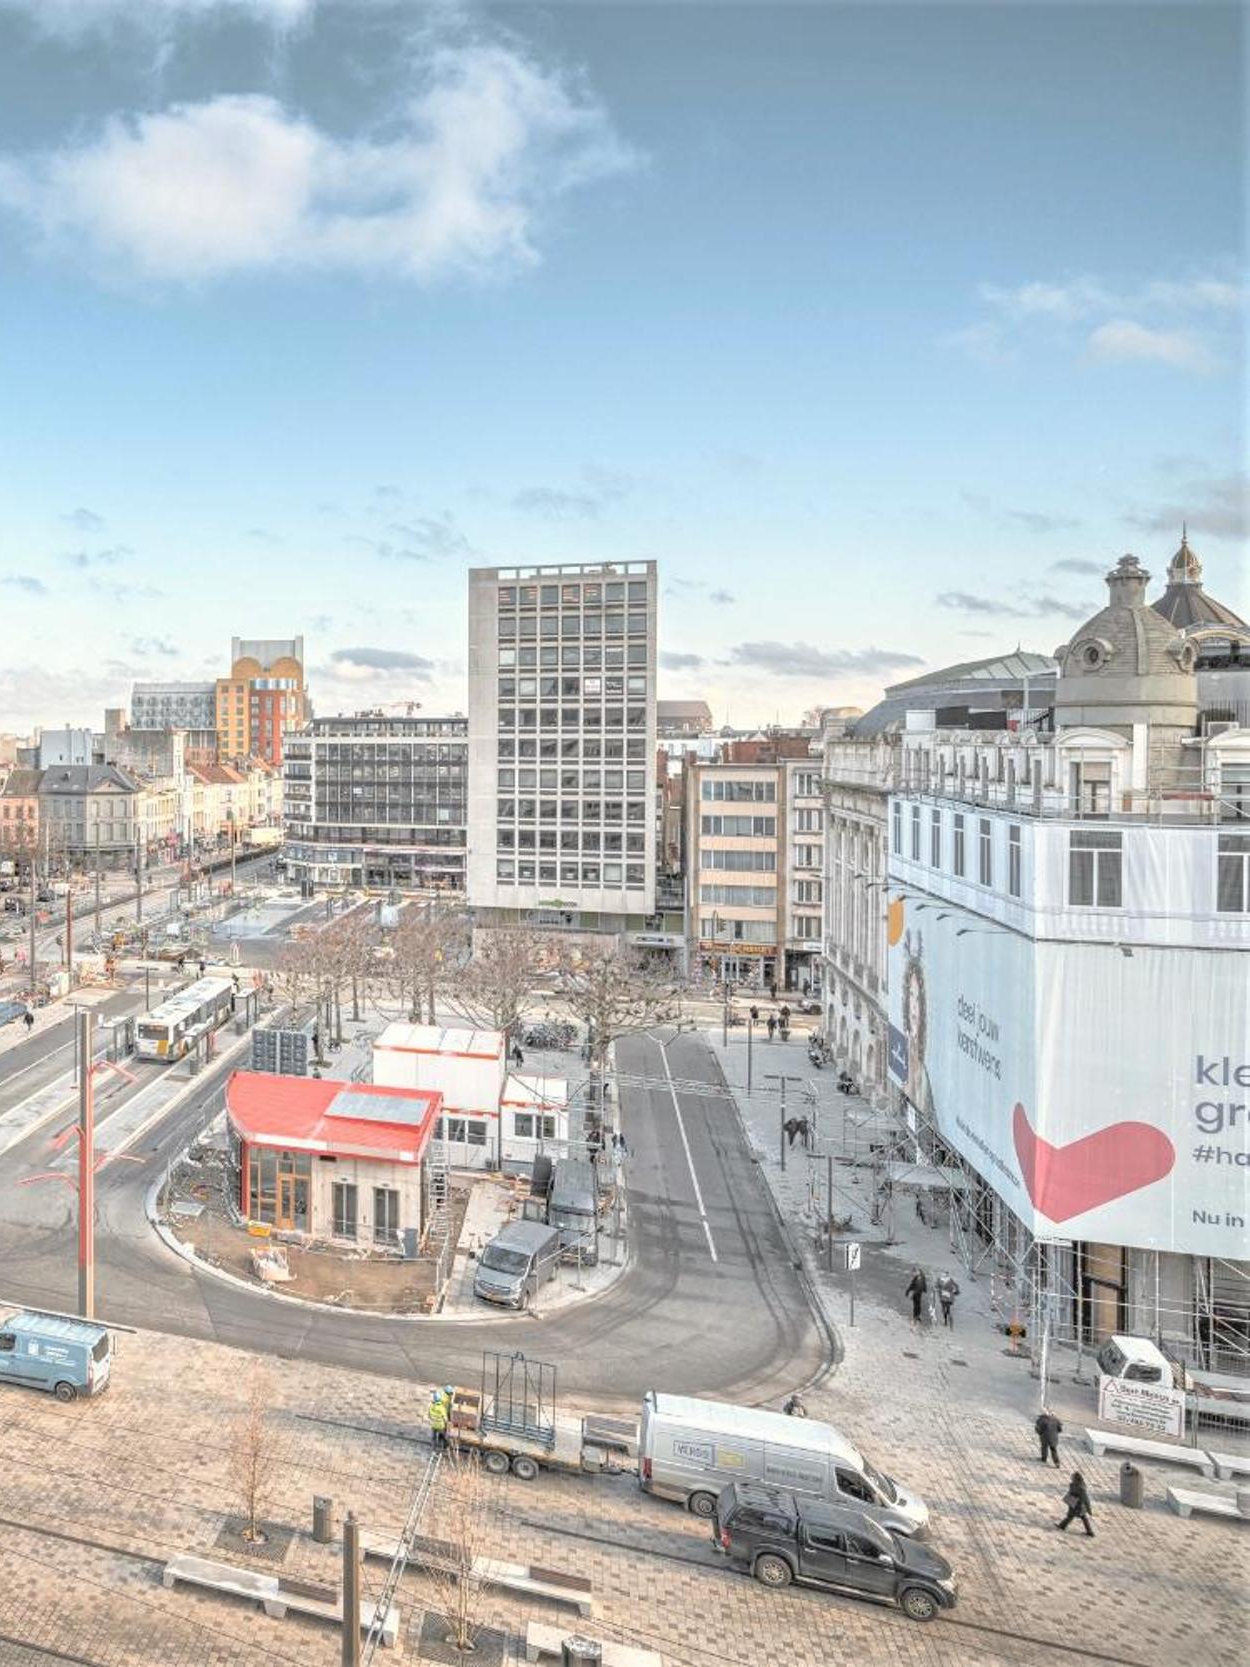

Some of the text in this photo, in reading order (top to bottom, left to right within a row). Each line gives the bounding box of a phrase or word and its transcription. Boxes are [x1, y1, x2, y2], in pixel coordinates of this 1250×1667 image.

[1195, 1101, 1250, 1134] gr
[1192, 1209, 1245, 1228] Nu in
